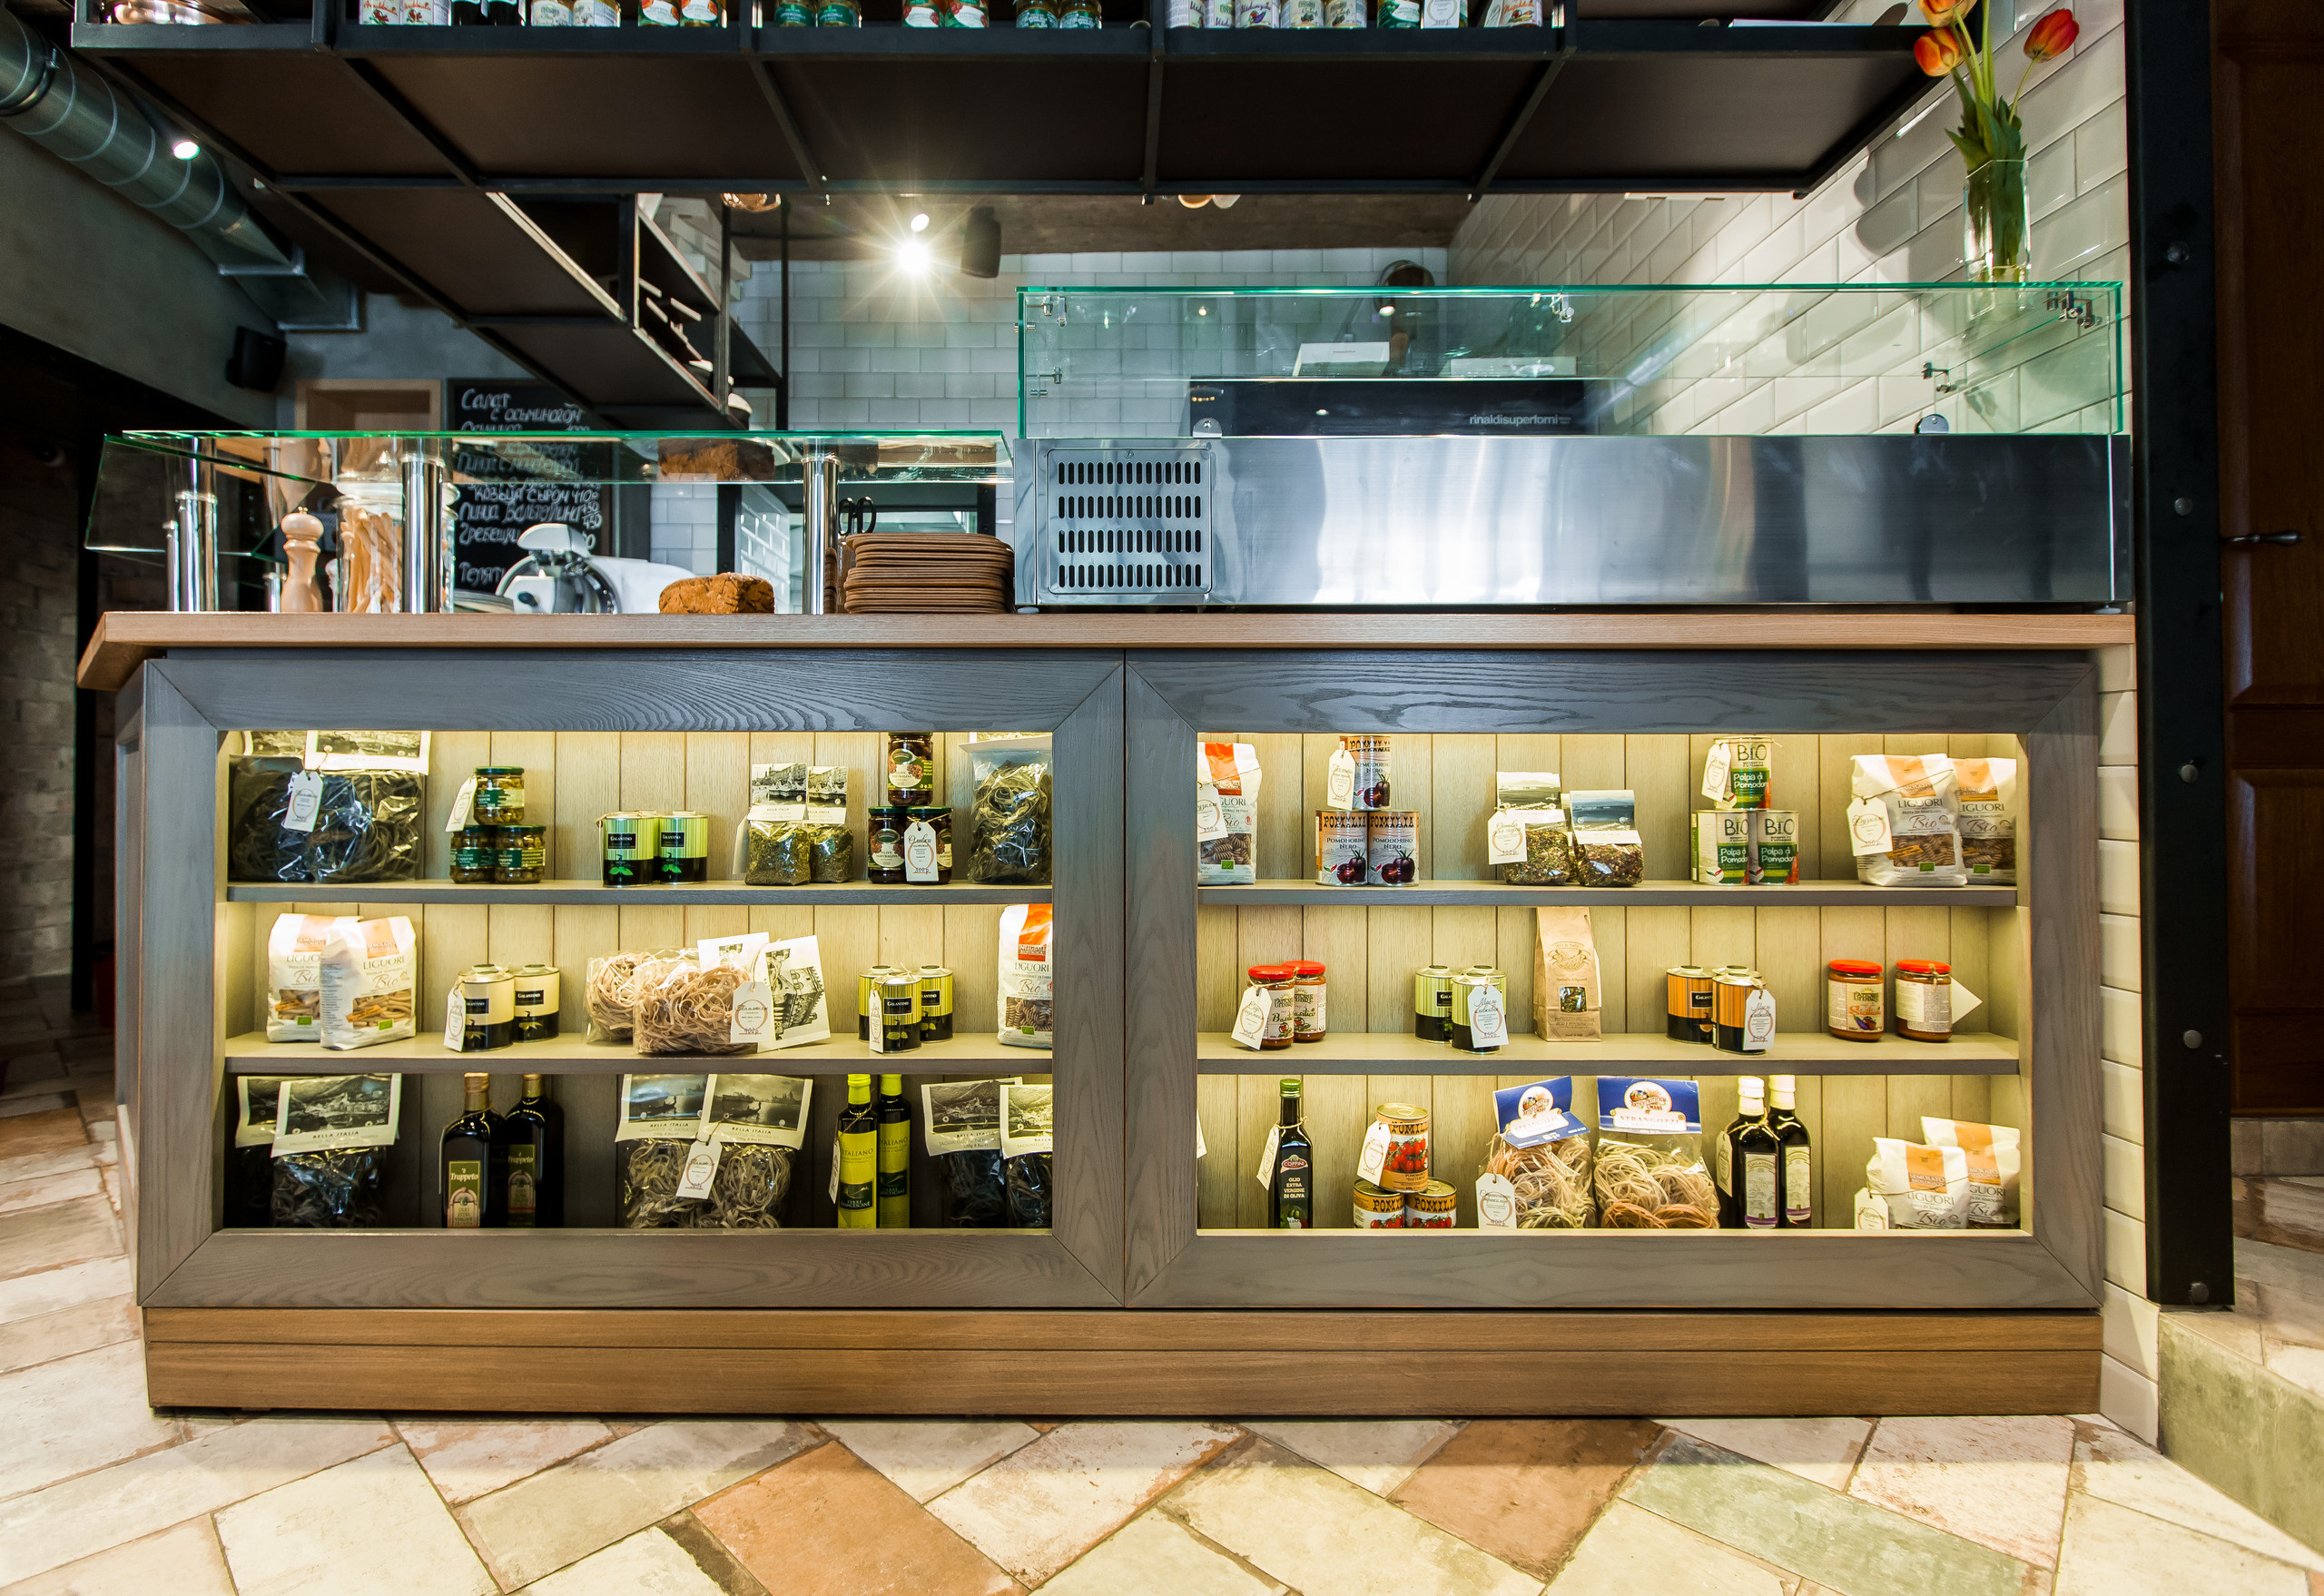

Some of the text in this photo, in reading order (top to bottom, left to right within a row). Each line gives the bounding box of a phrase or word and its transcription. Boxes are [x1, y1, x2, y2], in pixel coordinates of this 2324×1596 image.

[460, 388, 512, 409] Салат
[1738, 744, 1768, 762] BIO
[1733, 773, 1764, 783] Polpa di
[1220, 797, 1246, 806] GUORI
[1897, 798, 1944, 809] LIGUORI
[1724, 818, 1748, 836] BIO
[1765, 818, 1795, 835] BIO
[1908, 814, 1937, 830] Bio
[1966, 818, 1998, 832] Bio
[1720, 848, 1741, 857] Polpa
[1761, 846, 1791, 857] Polpa di
[1721, 855, 1748, 864] Pomodo
[286, 954, 320, 964] LIGUO
[362, 955, 406, 970] LIGUORI
[1014, 962, 1049, 973] LIGUORI
[372, 973, 399, 989] Bio
[1019, 979, 1041, 994] Bio
[1294, 1008, 1315, 1018] asilico
[881, 1137, 909, 1147] TALIANO
[842, 1148, 874, 1157] ITALIANO
[1969, 1184, 2006, 1197] GUORI
[1907, 1192, 1955, 1206] LIGUORI
[1916, 1209, 1946, 1227] Bio
